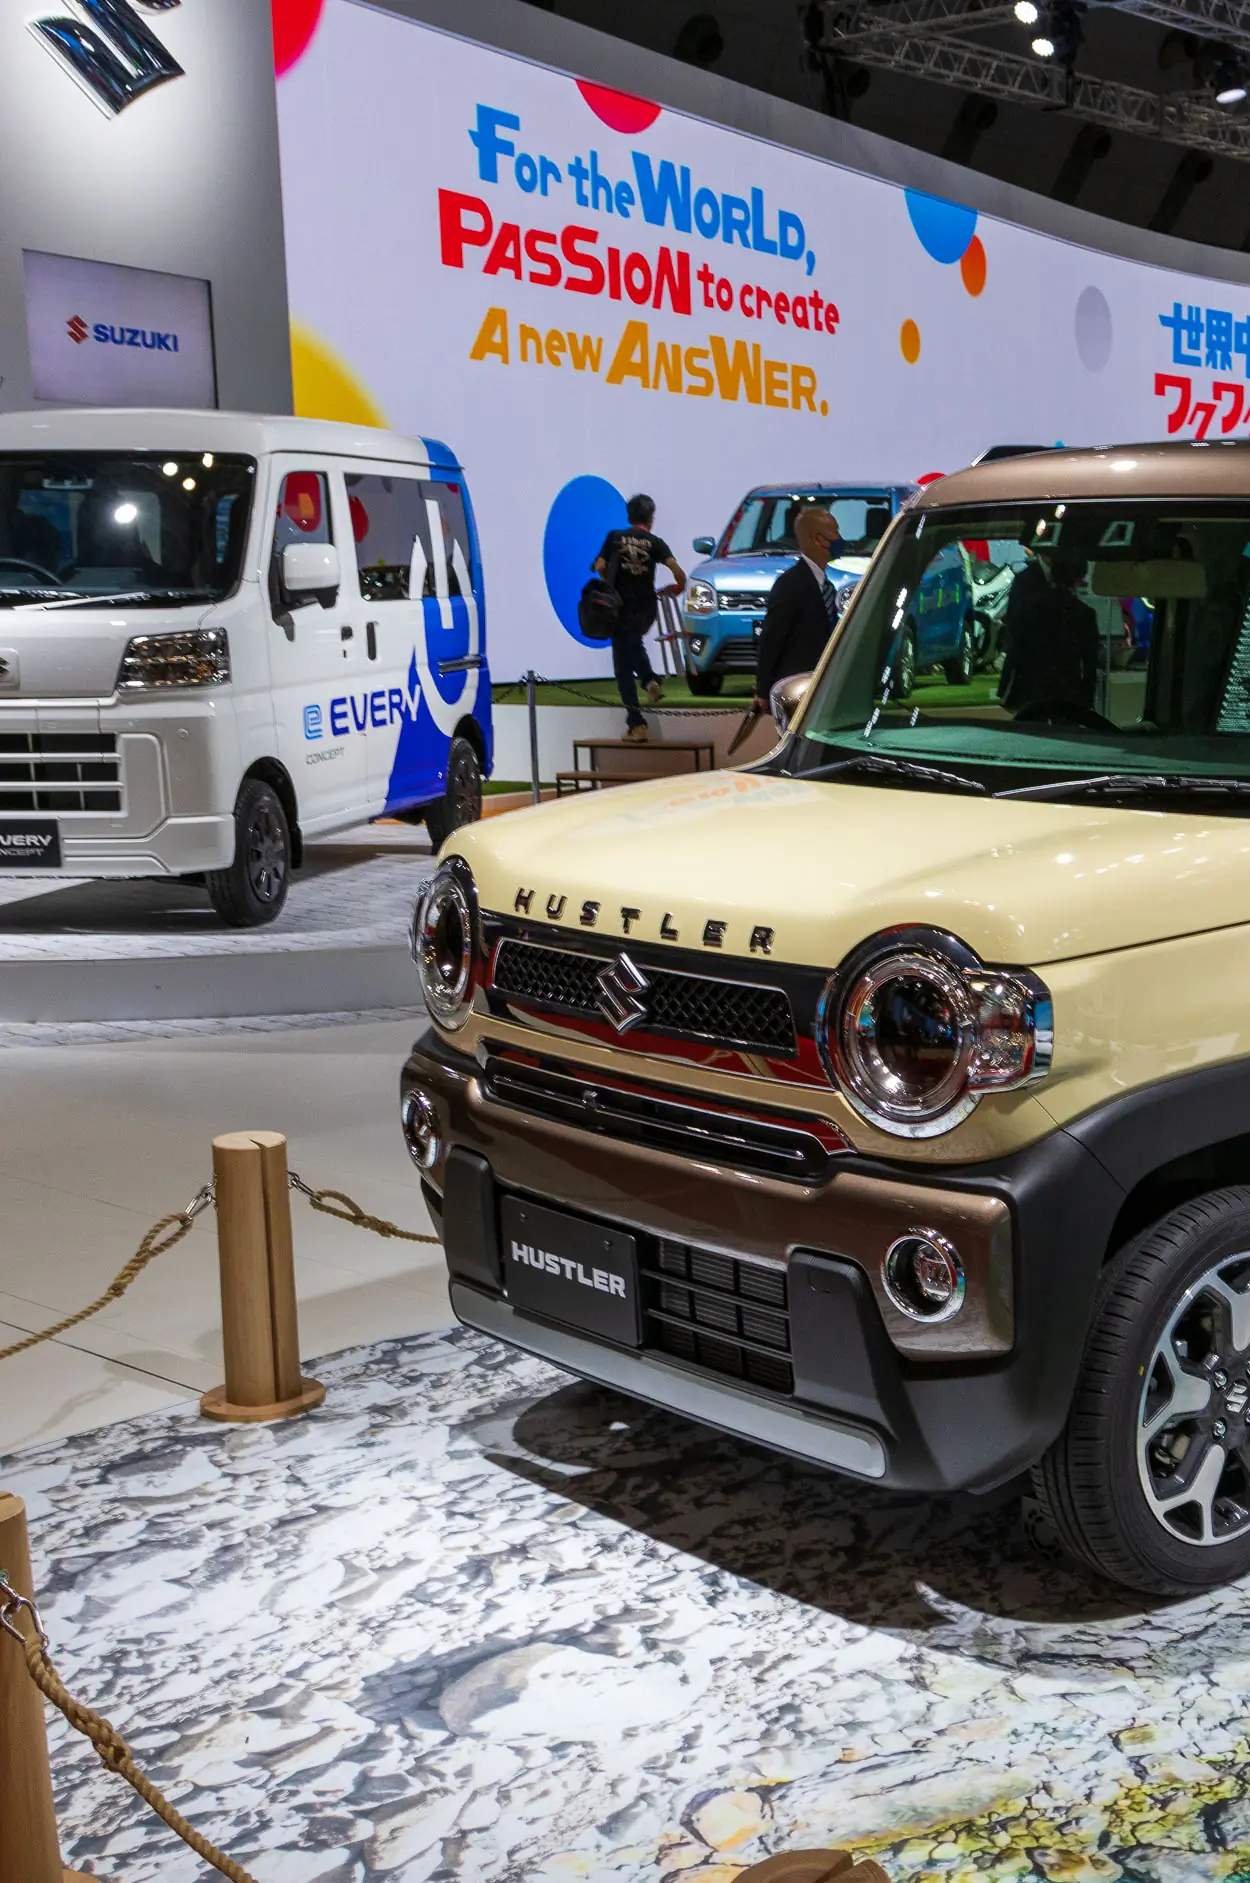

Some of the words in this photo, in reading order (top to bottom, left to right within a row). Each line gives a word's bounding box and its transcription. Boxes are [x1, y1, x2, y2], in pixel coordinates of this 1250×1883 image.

[466, 103, 563, 197] For
[567, 149, 636, 219] the
[438, 187, 692, 317] PASSION
[696, 262, 734, 312] to
[739, 283, 841, 335] create
[93, 323, 179, 353] SUZUKI
[469, 305, 510, 366] A
[518, 322, 604, 373] new
[330, 684, 421, 737] EVERY
[305, 747, 345, 765] CONCEPT
[0, 834, 52, 846] VERY
[0, 847, 44, 857] NCEPT
[514, 886, 776, 955] HUSTLER
[511, 1240, 627, 1298] HUSTLER
